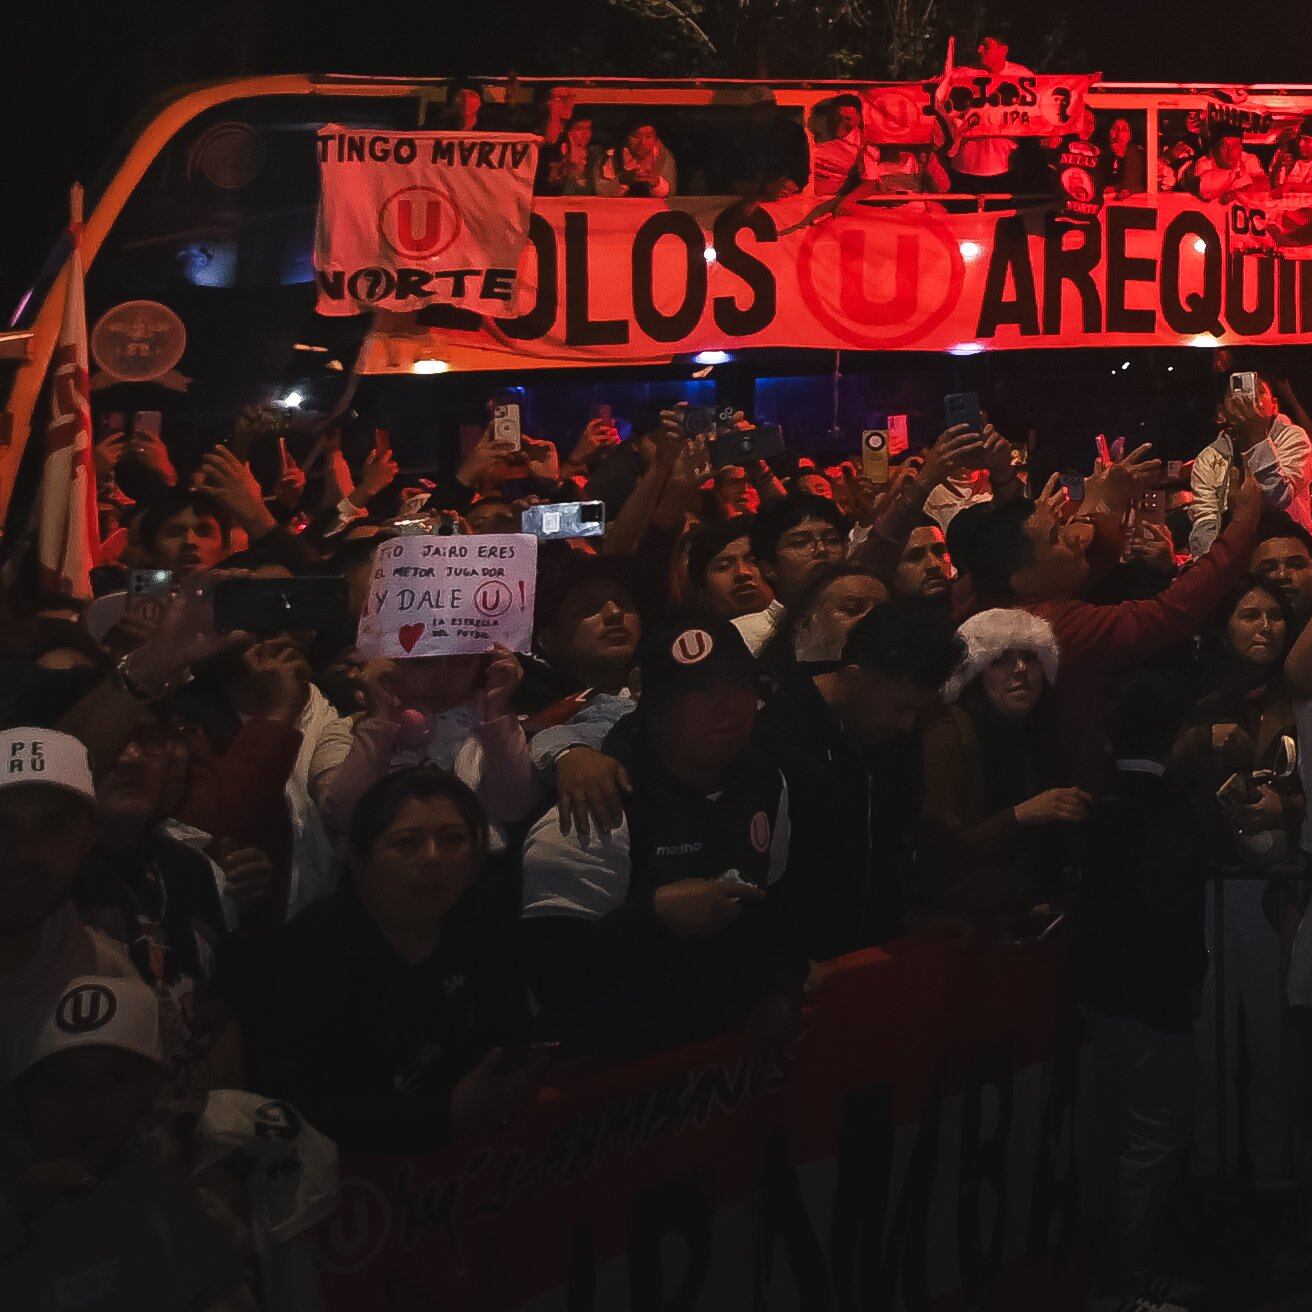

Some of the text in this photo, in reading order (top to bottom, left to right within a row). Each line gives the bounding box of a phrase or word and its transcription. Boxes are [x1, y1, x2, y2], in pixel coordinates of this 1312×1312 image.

[317, 133, 418, 165] TINGO
[477, 545, 516, 559] ERES
[375, 589, 389, 615] Y
[395, 588, 463, 612] DALE
